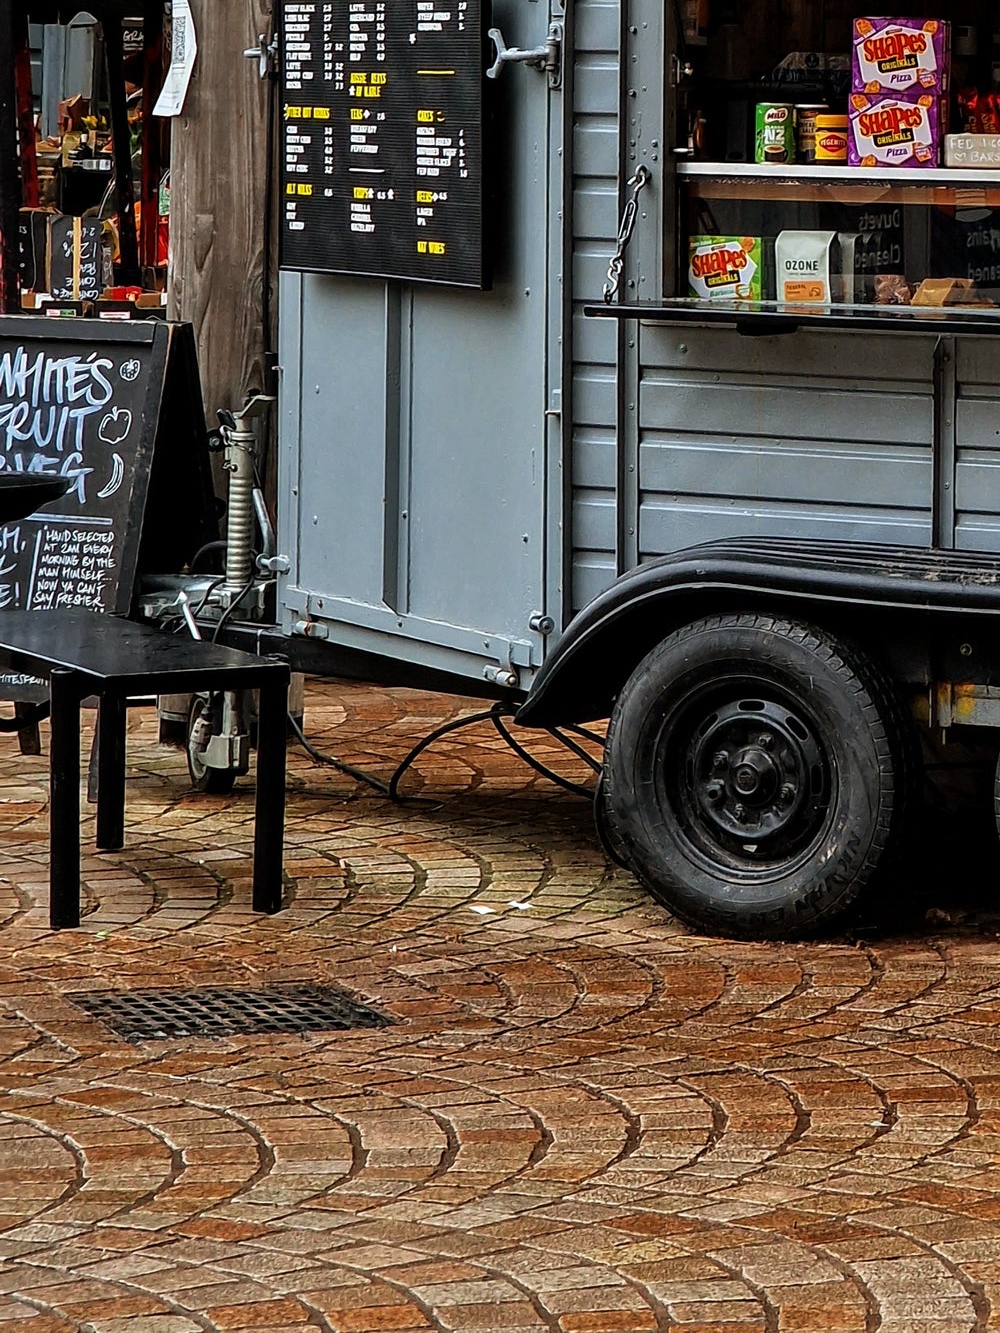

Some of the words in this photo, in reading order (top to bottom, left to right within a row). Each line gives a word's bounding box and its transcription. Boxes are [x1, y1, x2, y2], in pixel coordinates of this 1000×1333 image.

[890, 73, 913, 84] Pizza
[886, 147, 909, 158] Pizza
[785, 260, 818, 271] OZONE
[43, 543, 58, 552] AT
[83, 544, 114, 558] EVERY
[41, 556, 79, 566] MORNING
[37, 579, 59, 591] NOW
[32, 592, 55, 607] SAY
